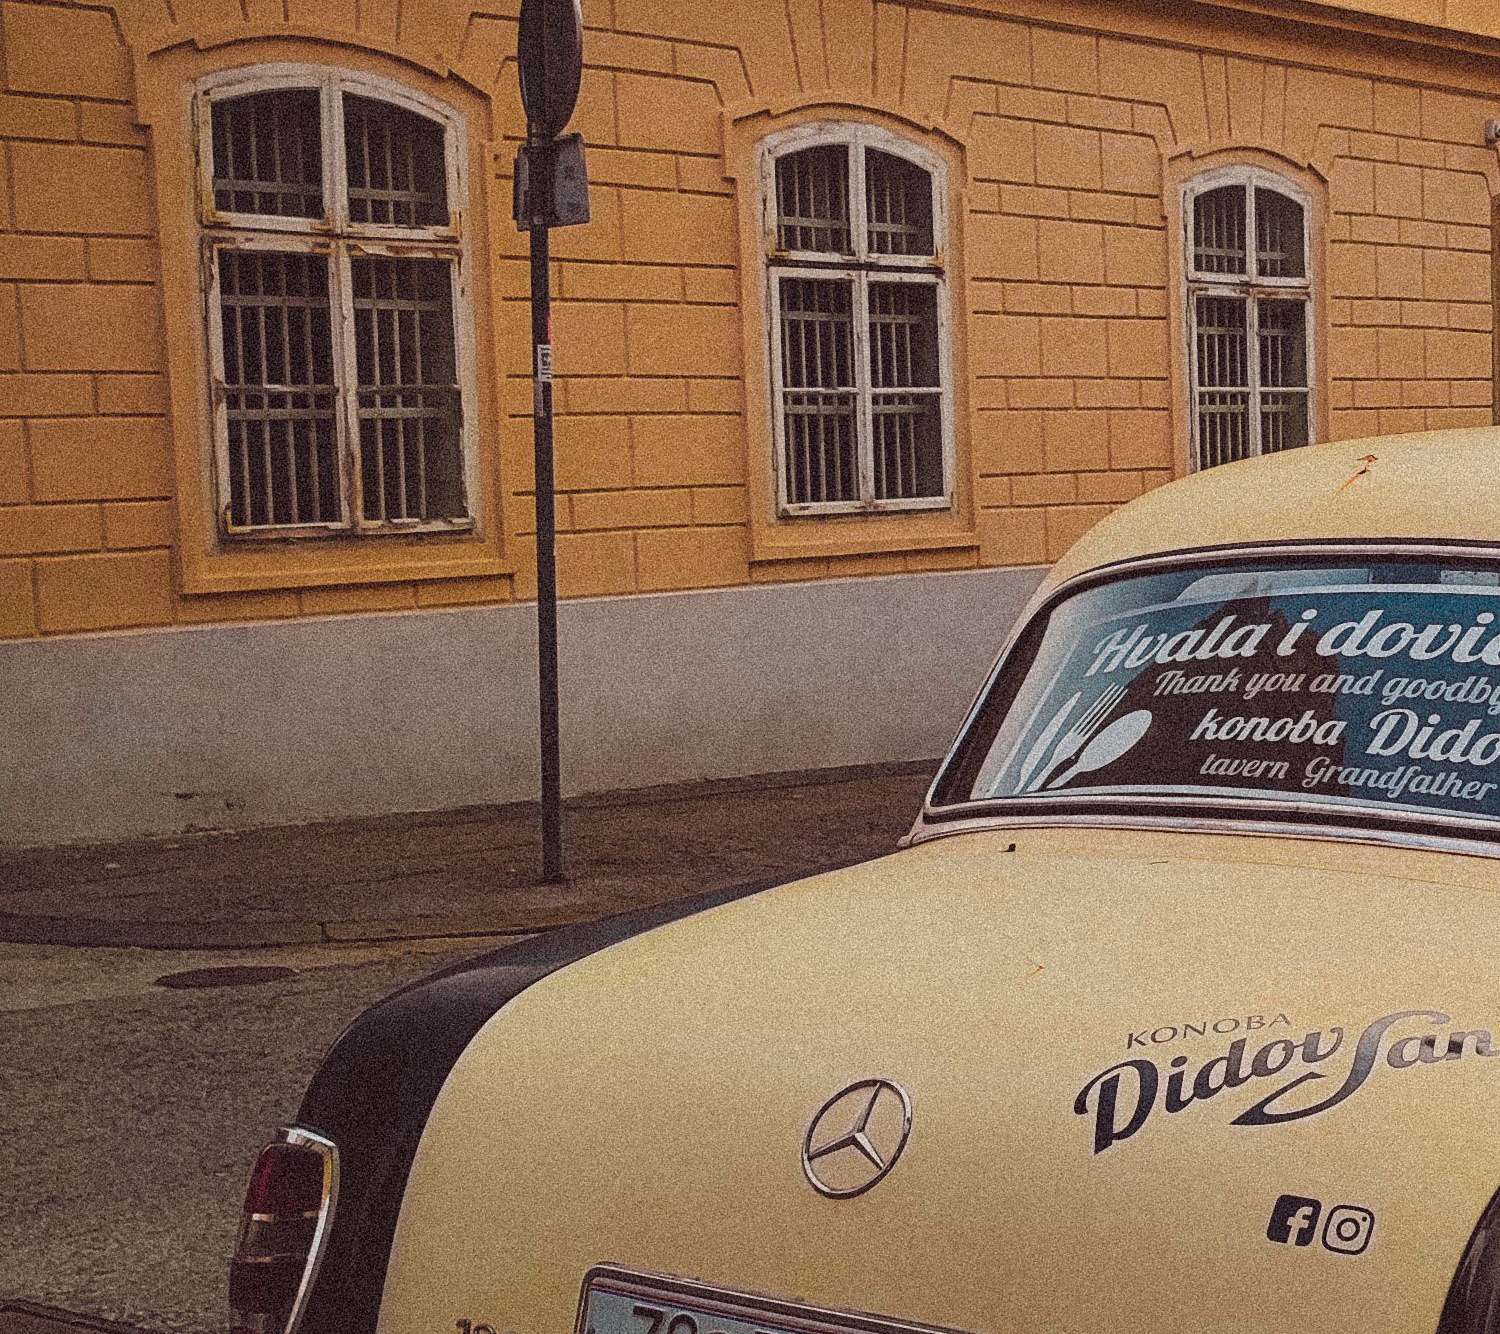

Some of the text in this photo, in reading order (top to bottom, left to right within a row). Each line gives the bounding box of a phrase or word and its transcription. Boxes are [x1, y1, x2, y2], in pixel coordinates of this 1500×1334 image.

[1086, 614, 1271, 677] Hvala
[1276, 608, 1318, 658] i
[1153, 667, 1240, 697] Thank
[1244, 671, 1309, 701] you
[1309, 669, 1376, 697] and
[1189, 707, 1347, 747] konoba
[1199, 753, 1289, 780] tavern
[1126, 1012, 1291, 1050] KONOBA
[1073, 1026, 1344, 1155] Didov
